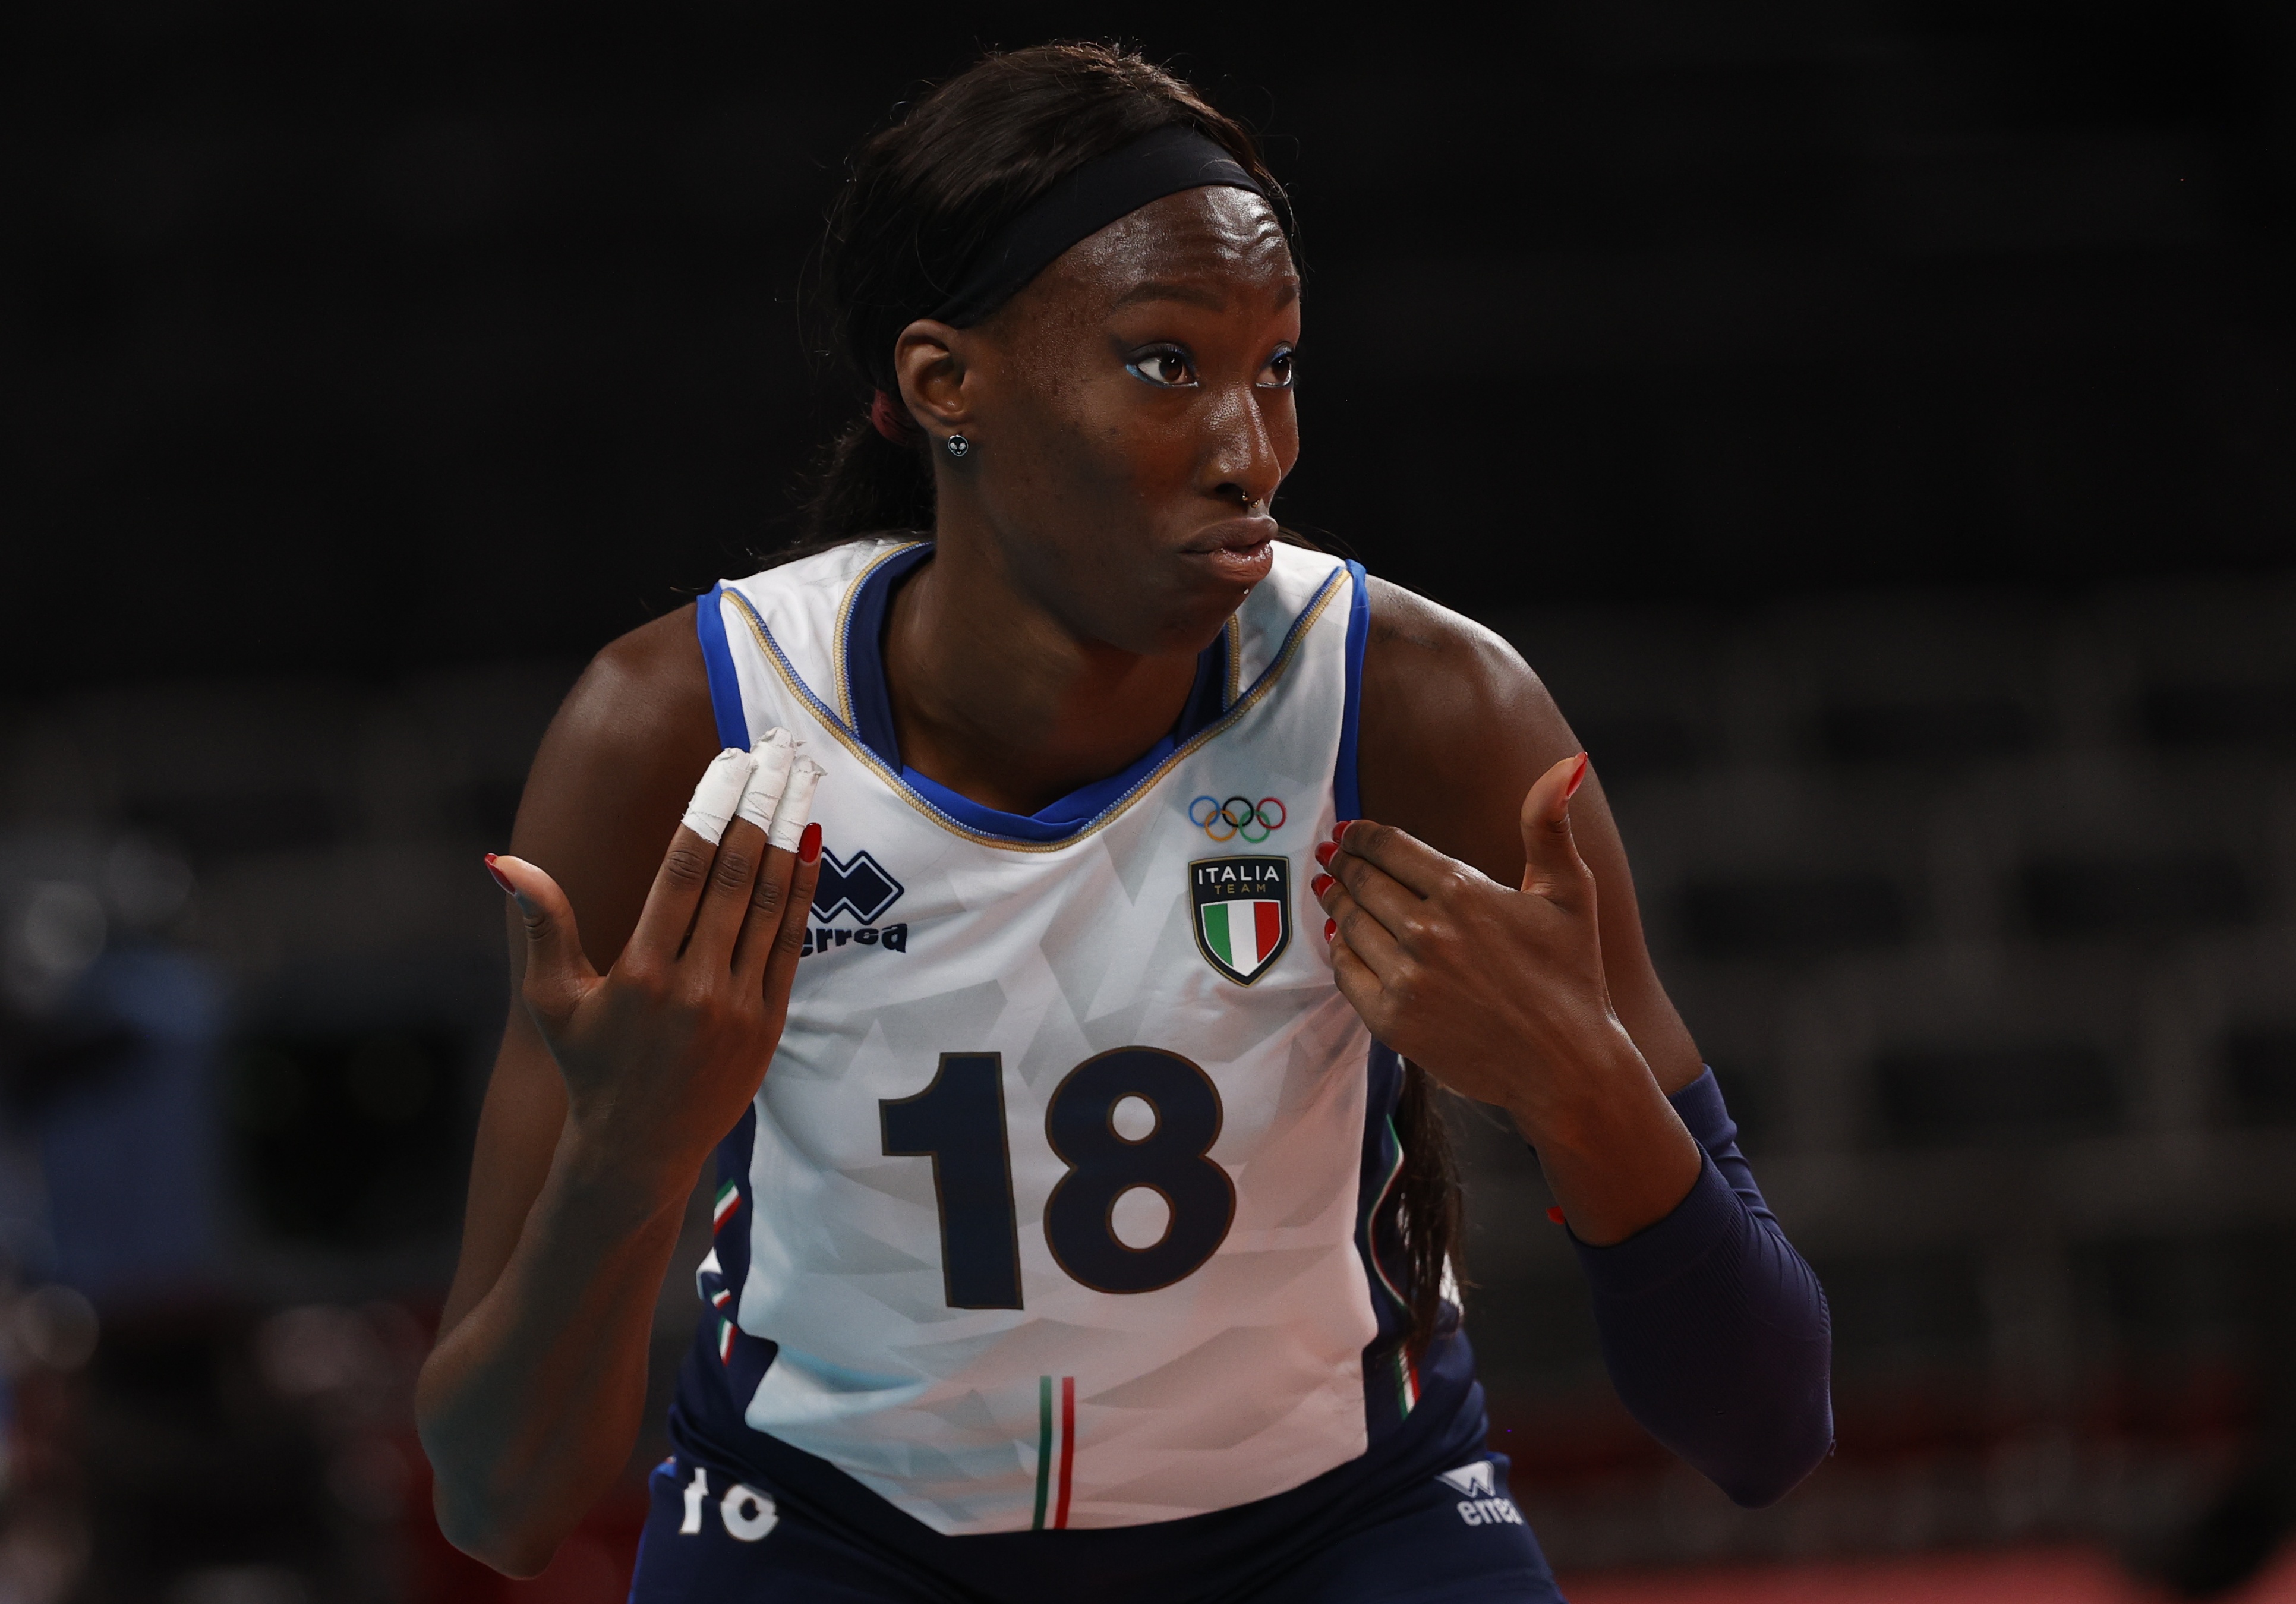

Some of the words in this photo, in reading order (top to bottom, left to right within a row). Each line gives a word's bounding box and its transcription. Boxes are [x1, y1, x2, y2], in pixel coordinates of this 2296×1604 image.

[1197, 865, 1279, 885] ITALIA
[1214, 884, 1266, 894] TEAM
[878, 1045, 1237, 1311] 18
